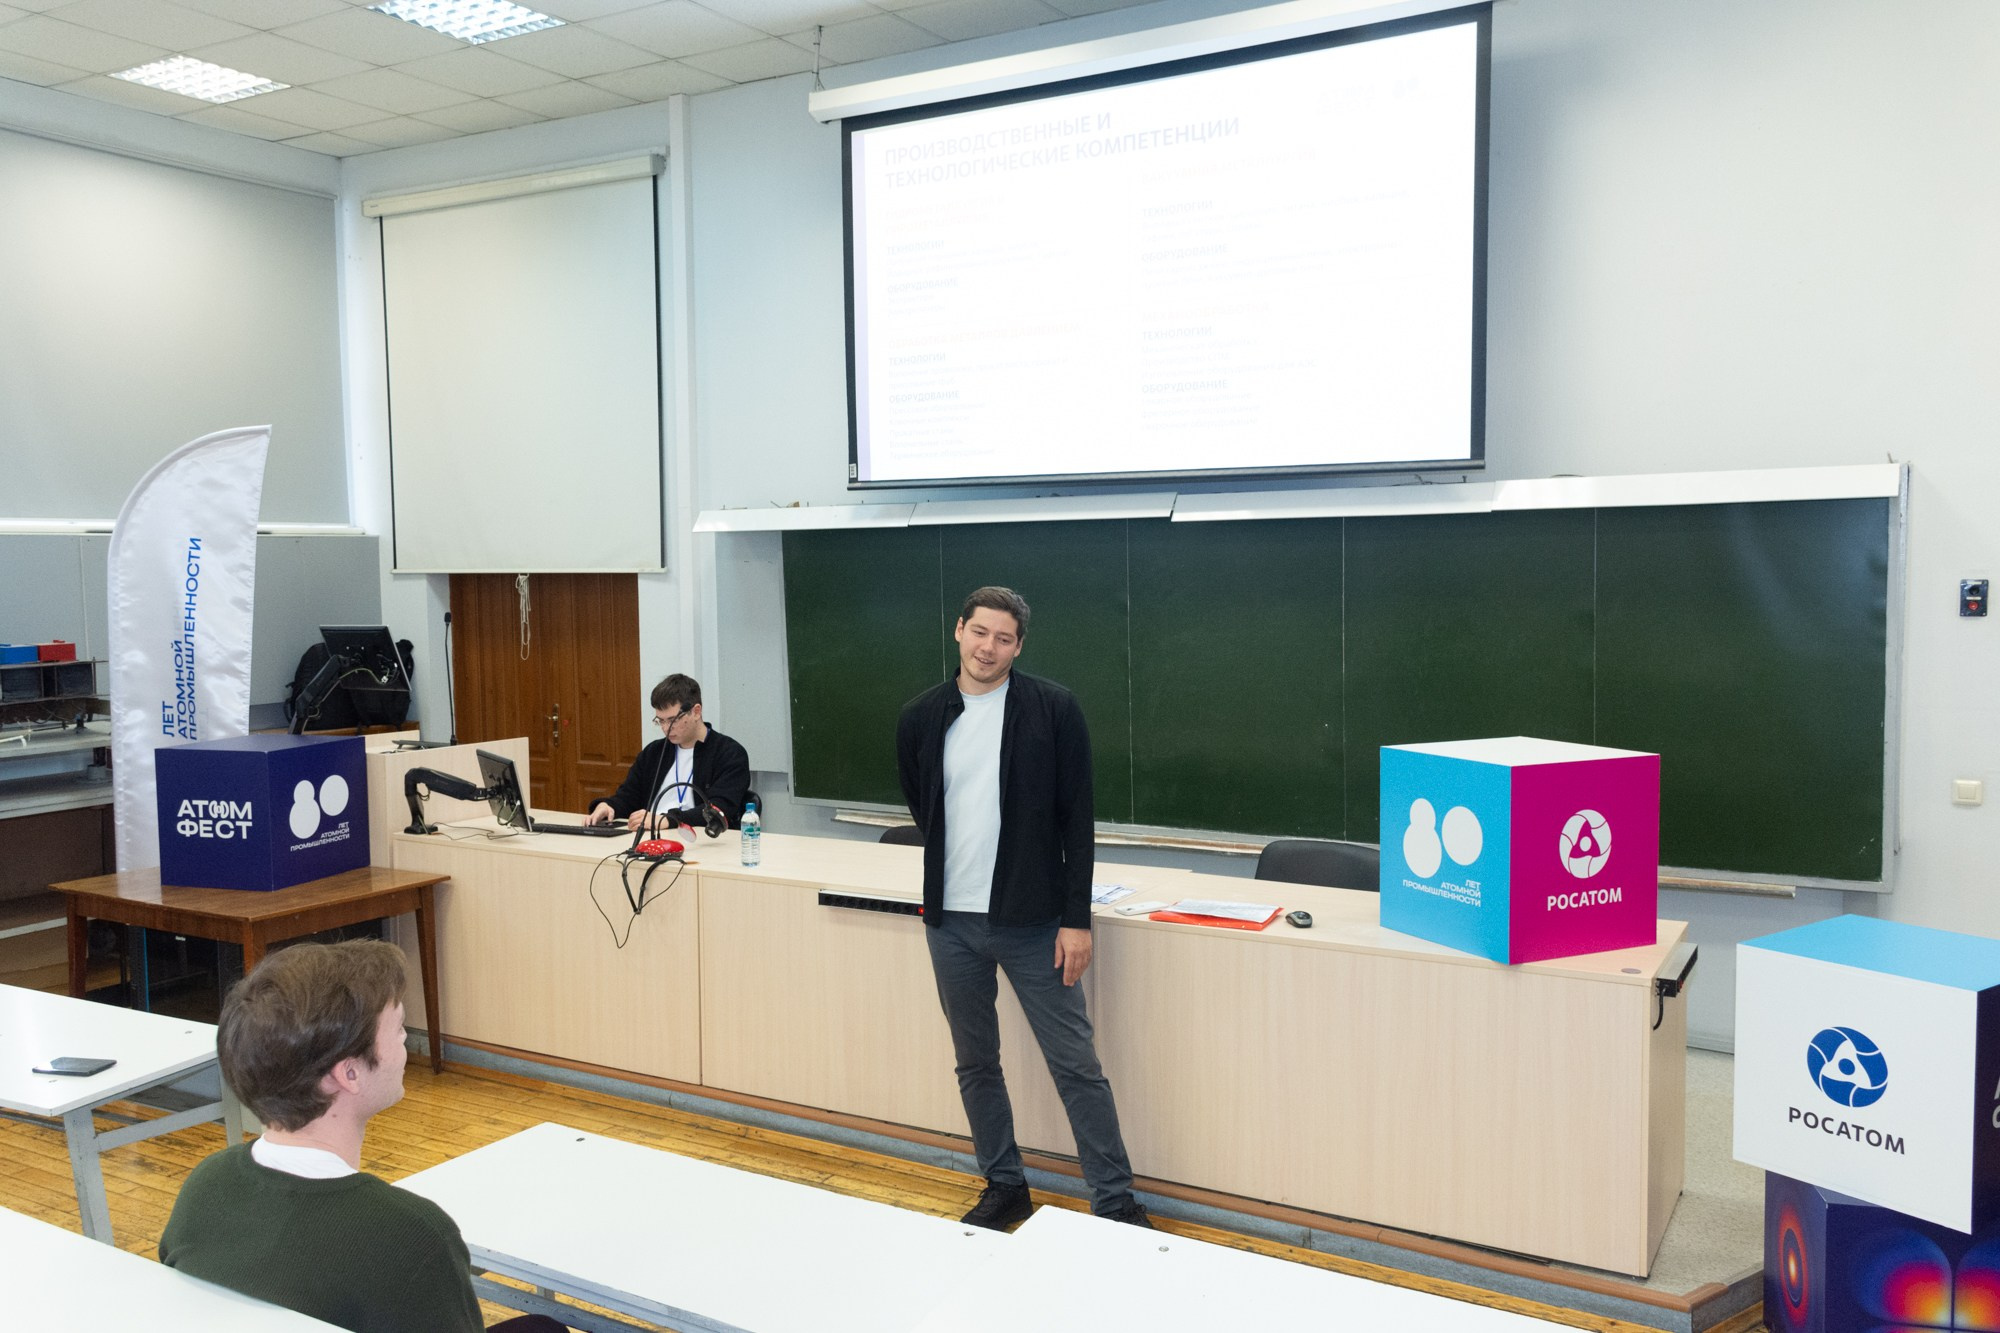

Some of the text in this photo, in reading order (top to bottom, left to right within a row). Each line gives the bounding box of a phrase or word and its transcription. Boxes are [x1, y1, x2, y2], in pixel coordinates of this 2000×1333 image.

[884, 111, 1112, 166] ПРОИЗВОДСТВЕННЫЕ И
[884, 117, 1240, 189] ТЕХНОЛОГИЧЕСКИЕ КОМПЕТЕНЦИИ
[1142, 199, 1214, 218] ТЕХНОЛОГИИ
[887, 239, 945, 256] ТЕХНОЛОГИИ
[1141, 243, 1229, 264] ОБОРУДОВАНИЕ
[887, 277, 959, 294] ОБОРУДОВАНИЕ
[1142, 325, 1213, 341] ТЕХНОЛОГИИ
[888, 352, 946, 367] ТЕХНОЛОГИИ
[1142, 379, 1229, 394] ОБОРУДОВАНИЕ
[888, 390, 961, 404] ОБОРУДОВАНИЕ
[185, 537, 202, 740] ПРОМЫШЛЕННОСТИ
[171, 640, 188, 739] АТОМНОЙ
[162, 701, 175, 737] ЛЕТ
[176, 799, 253, 820] АТОМ
[176, 819, 253, 840] ФЕСТ
[320, 827, 350, 839] АТОМНОЙ
[338, 821, 350, 829] ЛЕТ
[290, 833, 350, 851] ПРОМЫШЛЕННОСТИ
[1402, 879, 1481, 907] ПРОМЫШЛЕННОСТИ
[1441, 881, 1481, 898] АТОМНОЙ
[1465, 879, 1481, 890] ЛЕТ
[1547, 887, 1622, 911] РОСАТОМ
[1788, 1106, 1906, 1155] РОСАТОМ
